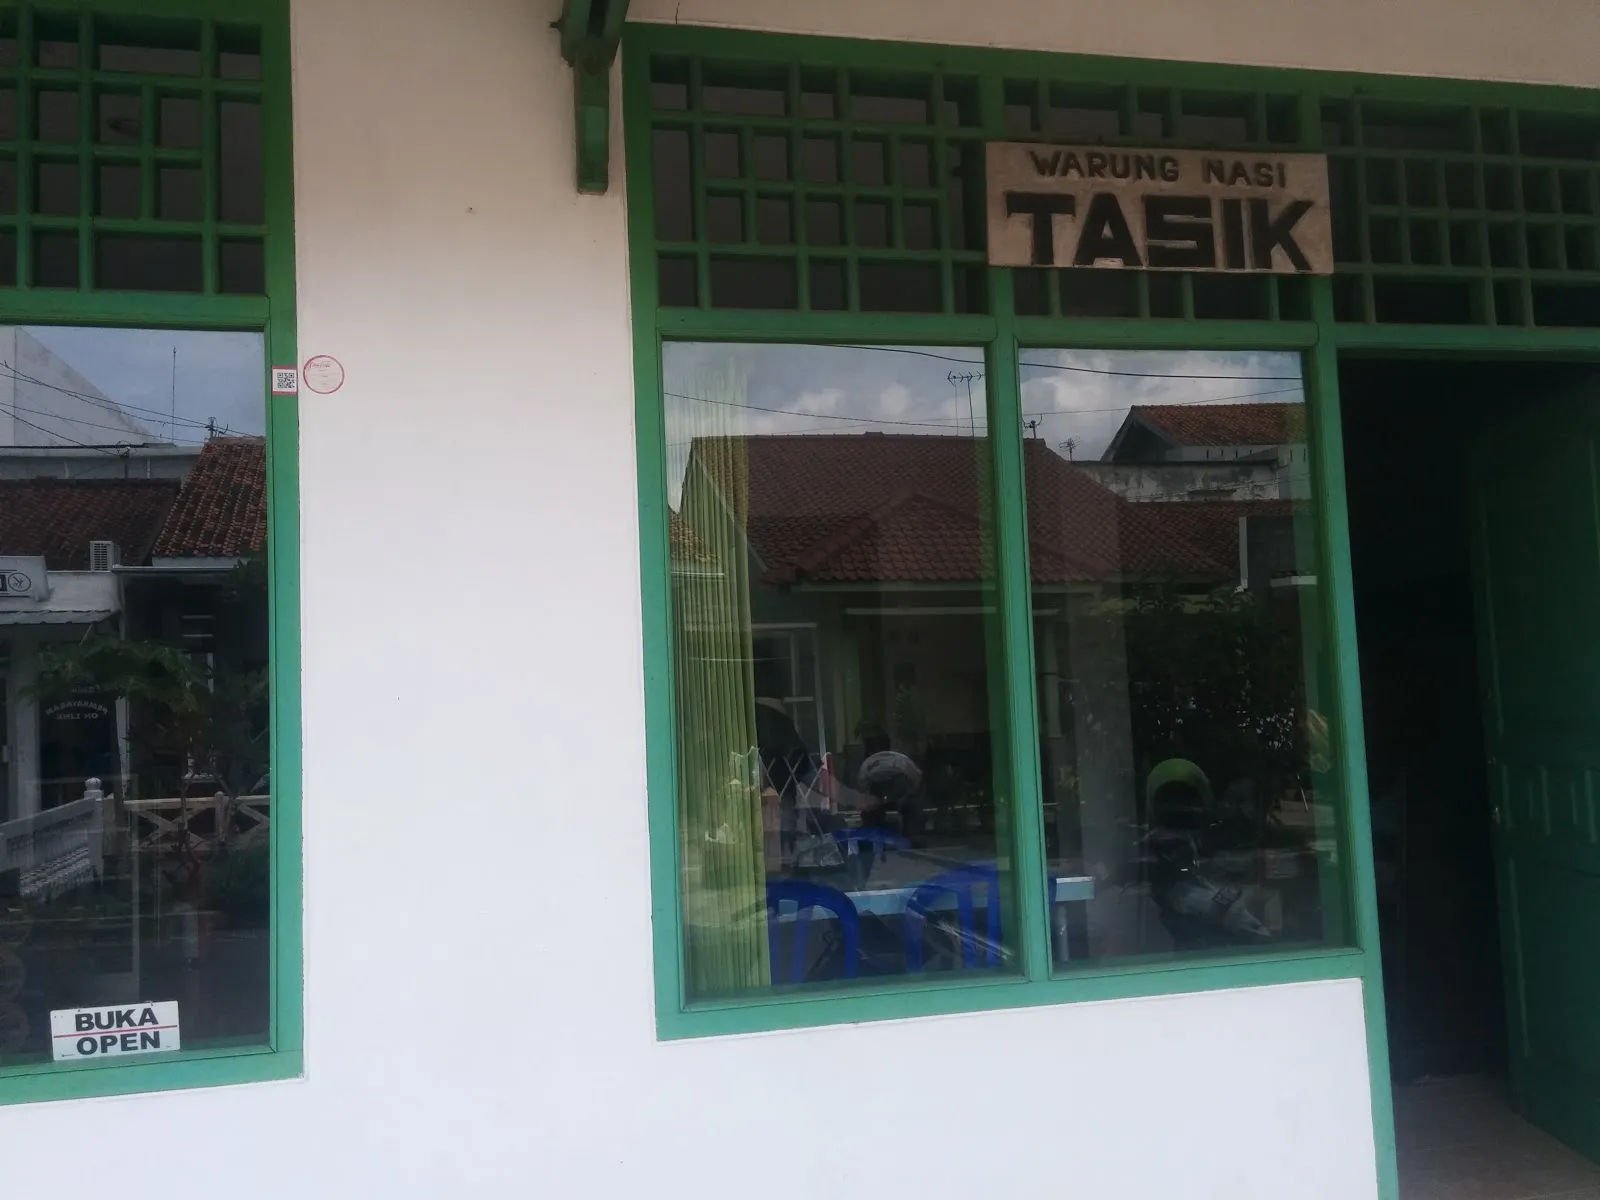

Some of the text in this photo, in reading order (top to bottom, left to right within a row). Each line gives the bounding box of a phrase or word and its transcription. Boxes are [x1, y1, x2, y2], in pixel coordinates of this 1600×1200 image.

[1029, 151, 1286, 188] WARUNG NASI
[1005, 192, 1314, 271] TASIK
[75, 1007, 159, 1031] BUKA
[76, 1031, 160, 1055] OPEN
